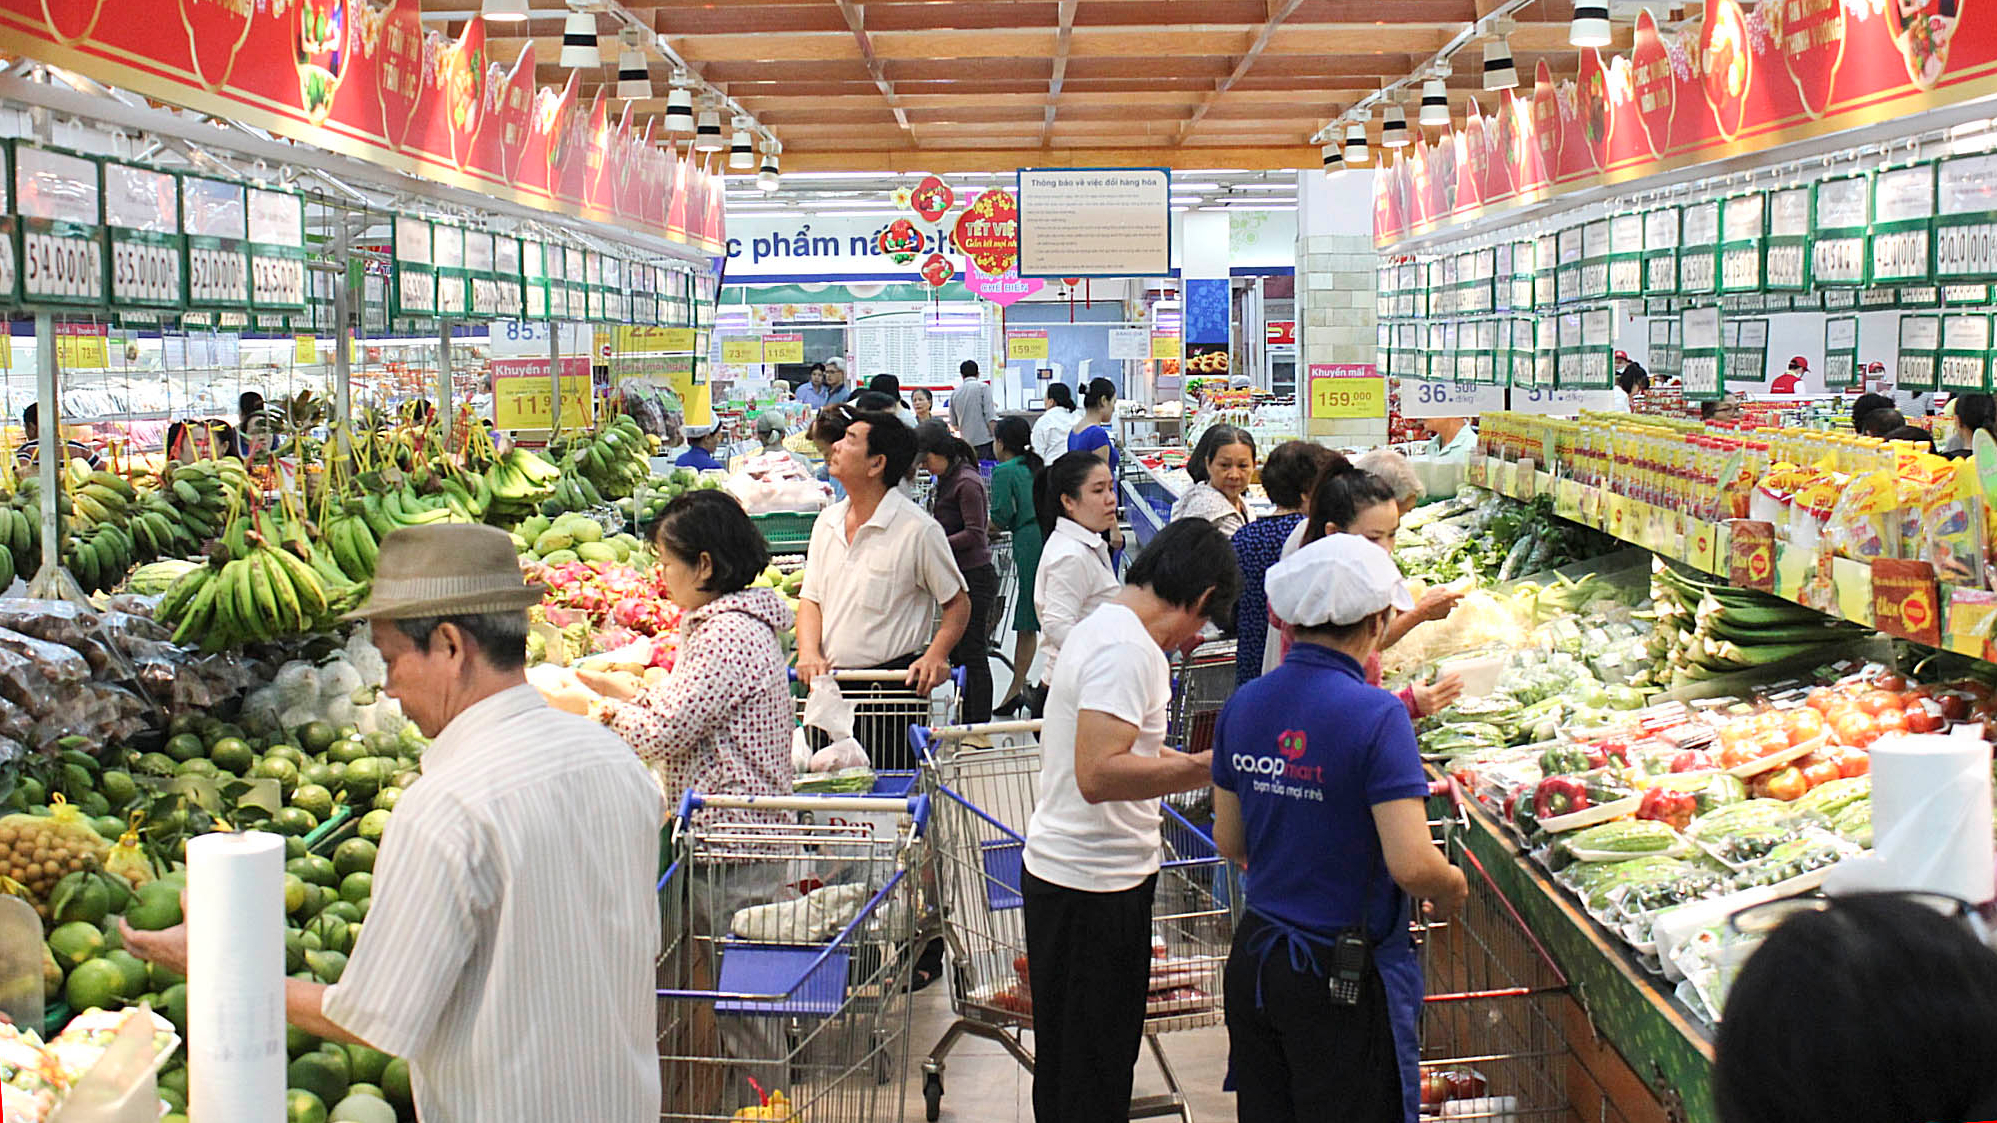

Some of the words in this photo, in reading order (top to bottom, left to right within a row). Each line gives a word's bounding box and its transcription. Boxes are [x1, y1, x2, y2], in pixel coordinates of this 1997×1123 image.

[1031, 178, 1056, 187] Thông
[1058, 178, 1073, 187] báo
[1076, 178, 1084, 187] về
[1087, 177, 1102, 187] việc
[1105, 177, 1118, 187] đổi
[1120, 178, 1140, 187] hàng
[1141, 177, 1157, 186] hóa
[966, 219, 991, 237] TẾT
[992, 219, 1017, 239] VIỆ
[754, 225, 839, 264] phẩm
[850, 224, 884, 256] nấ
[981, 280, 1002, 293] CHẾ
[1003, 280, 1029, 293] BIẾN
[495, 363, 540, 377] Khuyến
[1311, 367, 1346, 378] Khuyến
[1348, 366, 1365, 376] mãi
[1253, 779, 1270, 795] bạn
[1286, 786, 1302, 800] mọi
[1304, 788, 1324, 802] nhà
